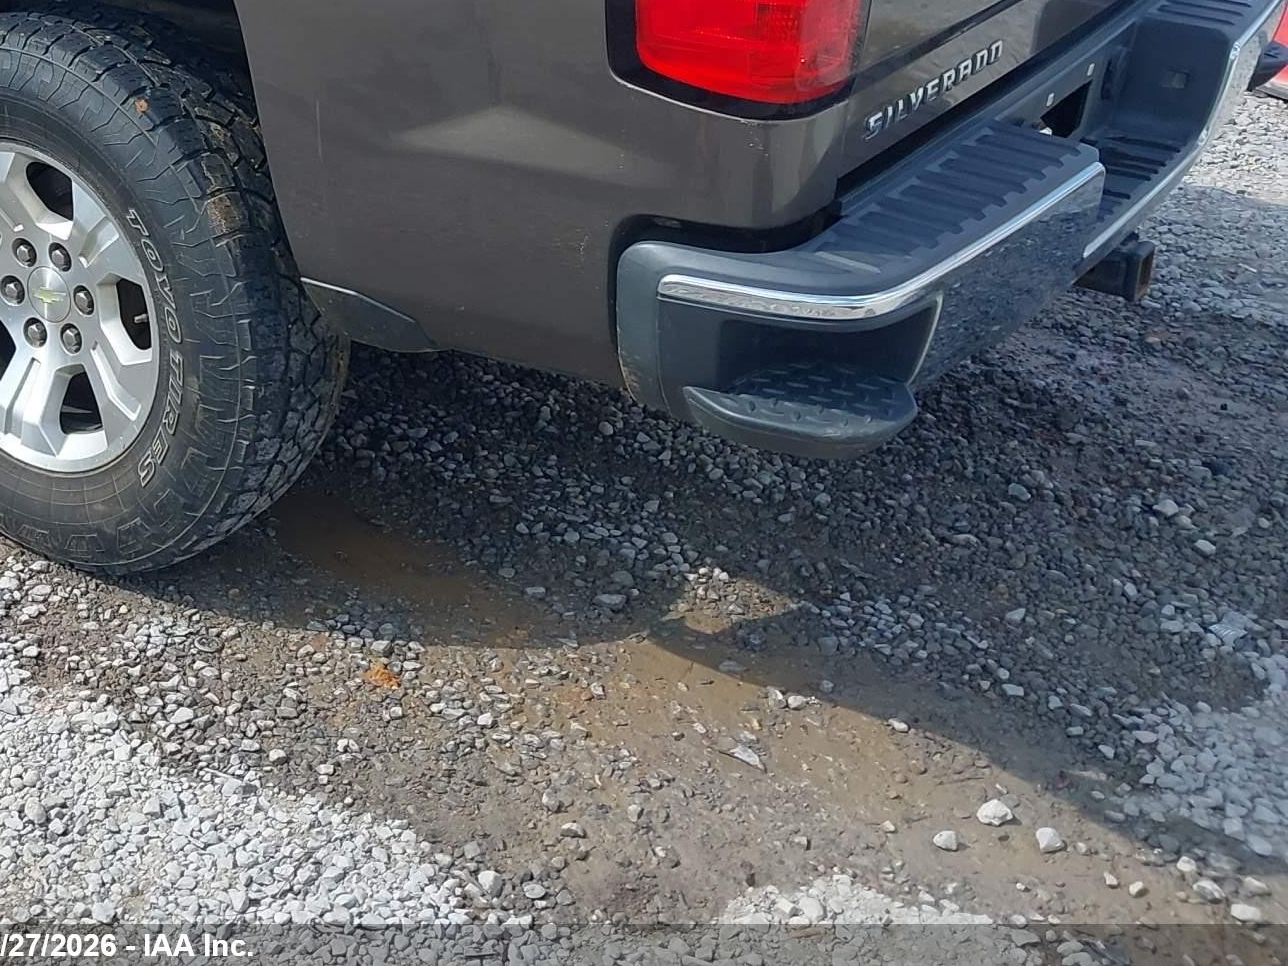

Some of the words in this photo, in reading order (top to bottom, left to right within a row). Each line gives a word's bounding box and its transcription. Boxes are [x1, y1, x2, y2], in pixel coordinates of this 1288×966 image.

[863, 39, 1003, 140] SILVERADO
[125, 208, 183, 344] TOYO
[137, 350, 184, 489] TIRES
